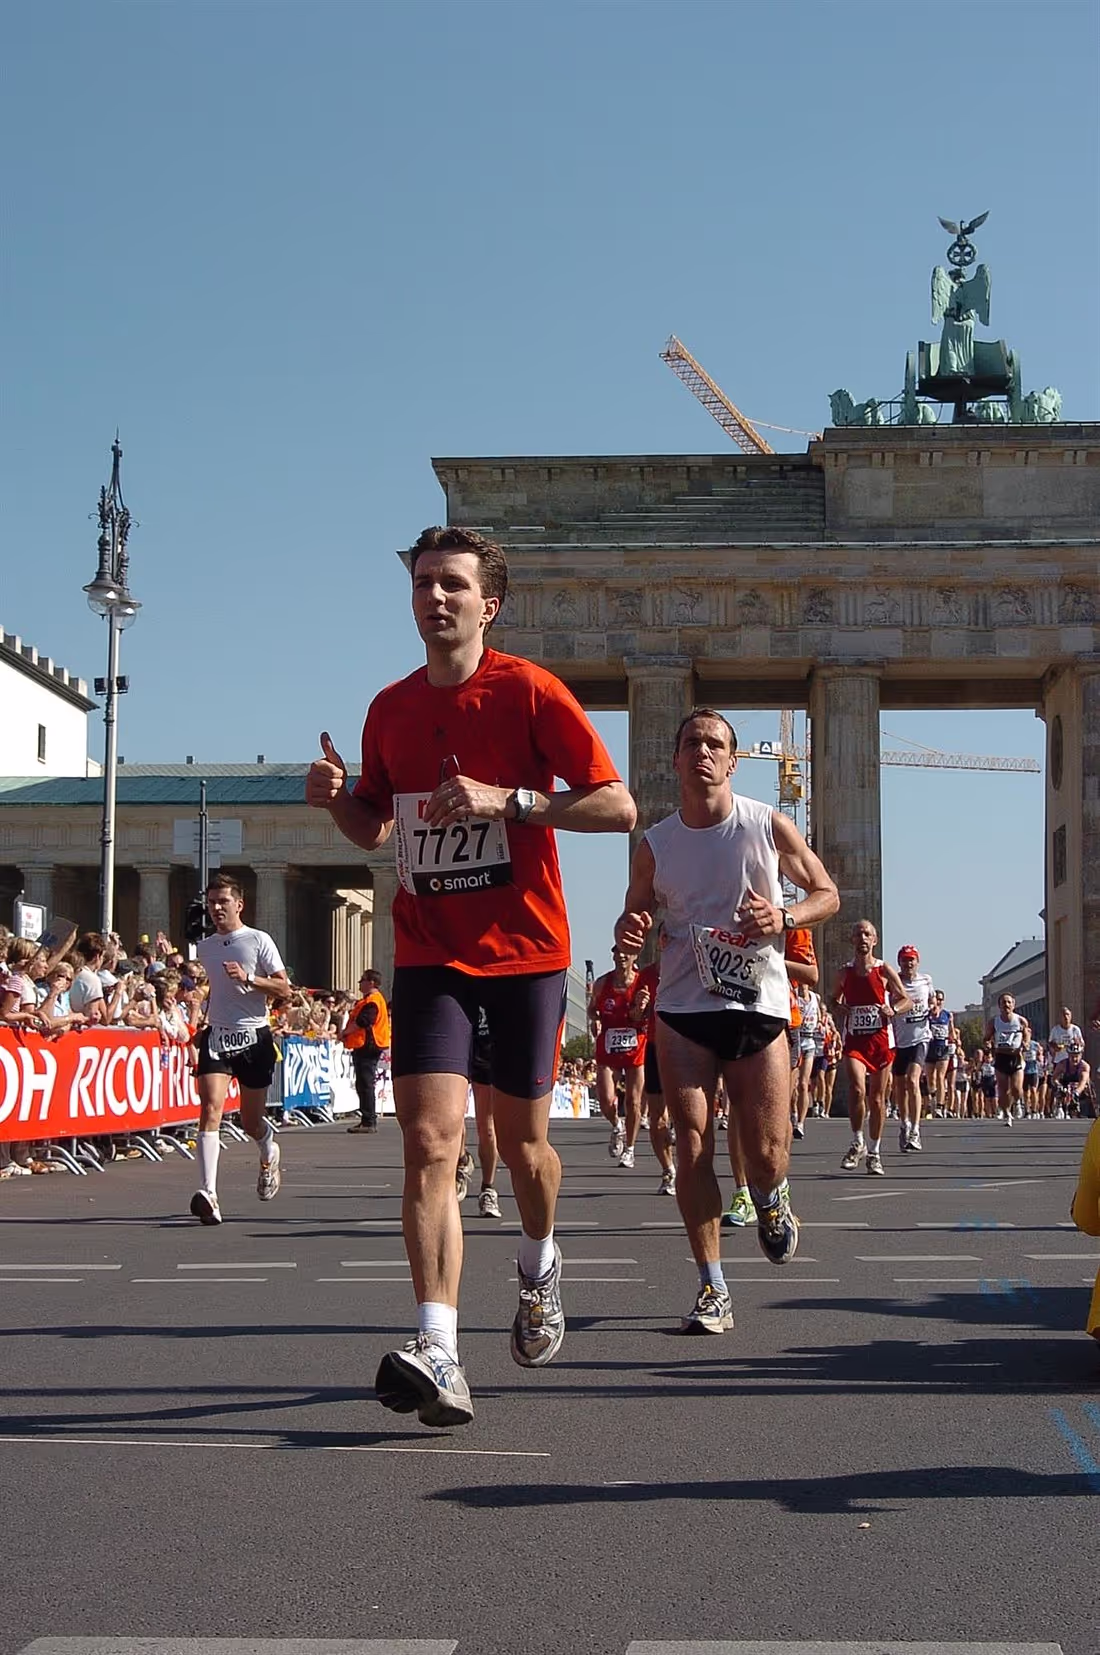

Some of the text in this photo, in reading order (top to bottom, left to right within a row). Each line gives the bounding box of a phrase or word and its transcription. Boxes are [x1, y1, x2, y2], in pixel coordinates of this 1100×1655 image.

[413, 822, 491, 865] 7727
[444, 872, 491, 891] smart
[854, 1015, 877, 1027] 3397
[219, 1030, 250, 1048] 18006
